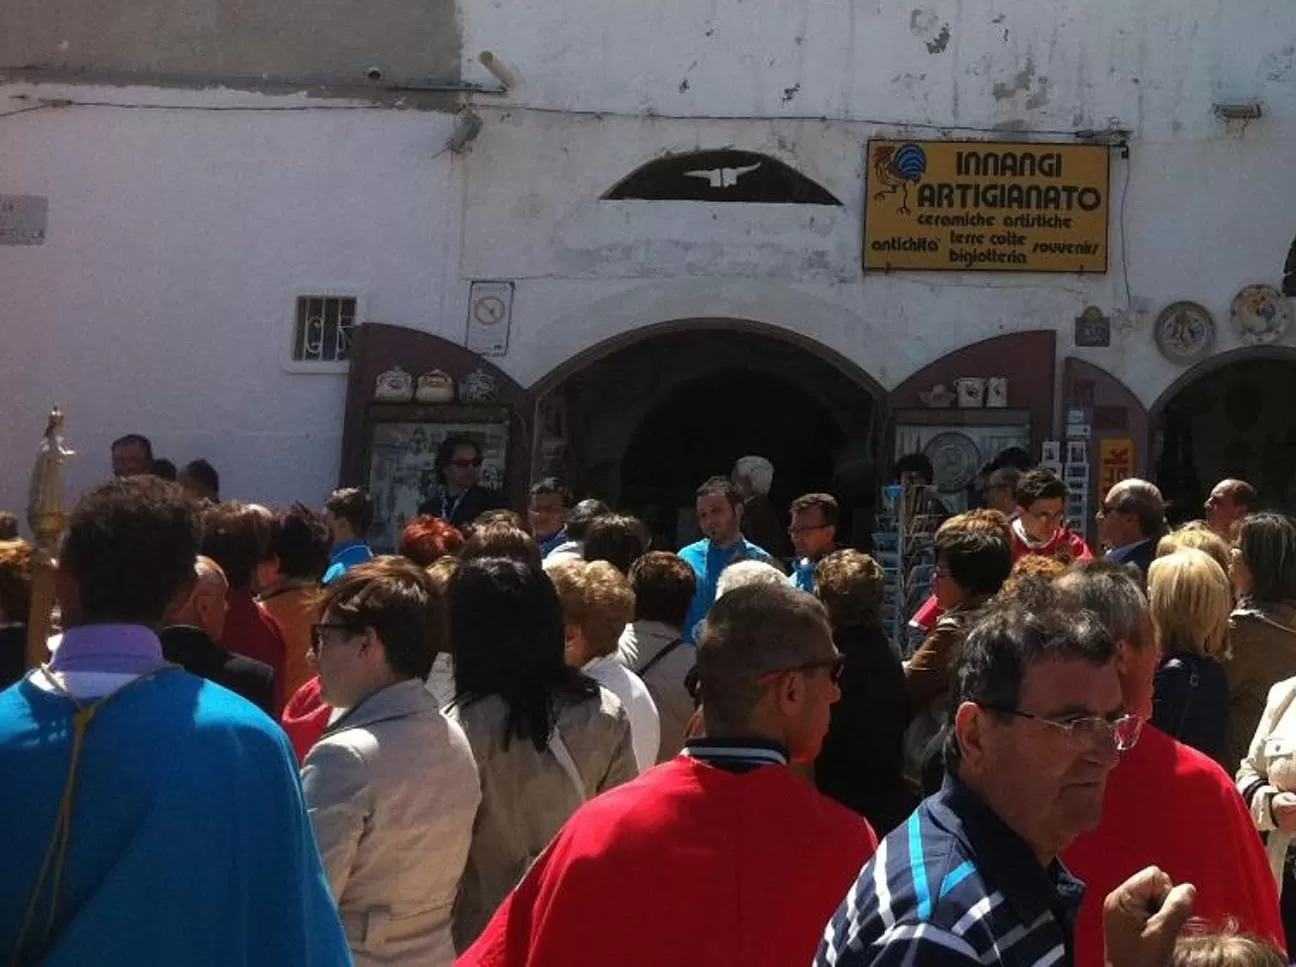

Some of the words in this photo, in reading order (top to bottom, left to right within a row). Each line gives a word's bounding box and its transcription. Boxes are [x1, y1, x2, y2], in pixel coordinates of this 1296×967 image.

[917, 183, 1101, 212] ARTIGIANATO
[918, 213, 995, 227] ceramiche
[1004, 214, 1072, 229] artistiche
[951, 230, 985, 245] terre
[990, 233, 1027, 246] cotte
[1032, 240, 1098, 254] souvenirs
[950, 248, 1027, 268] bigiotteria
